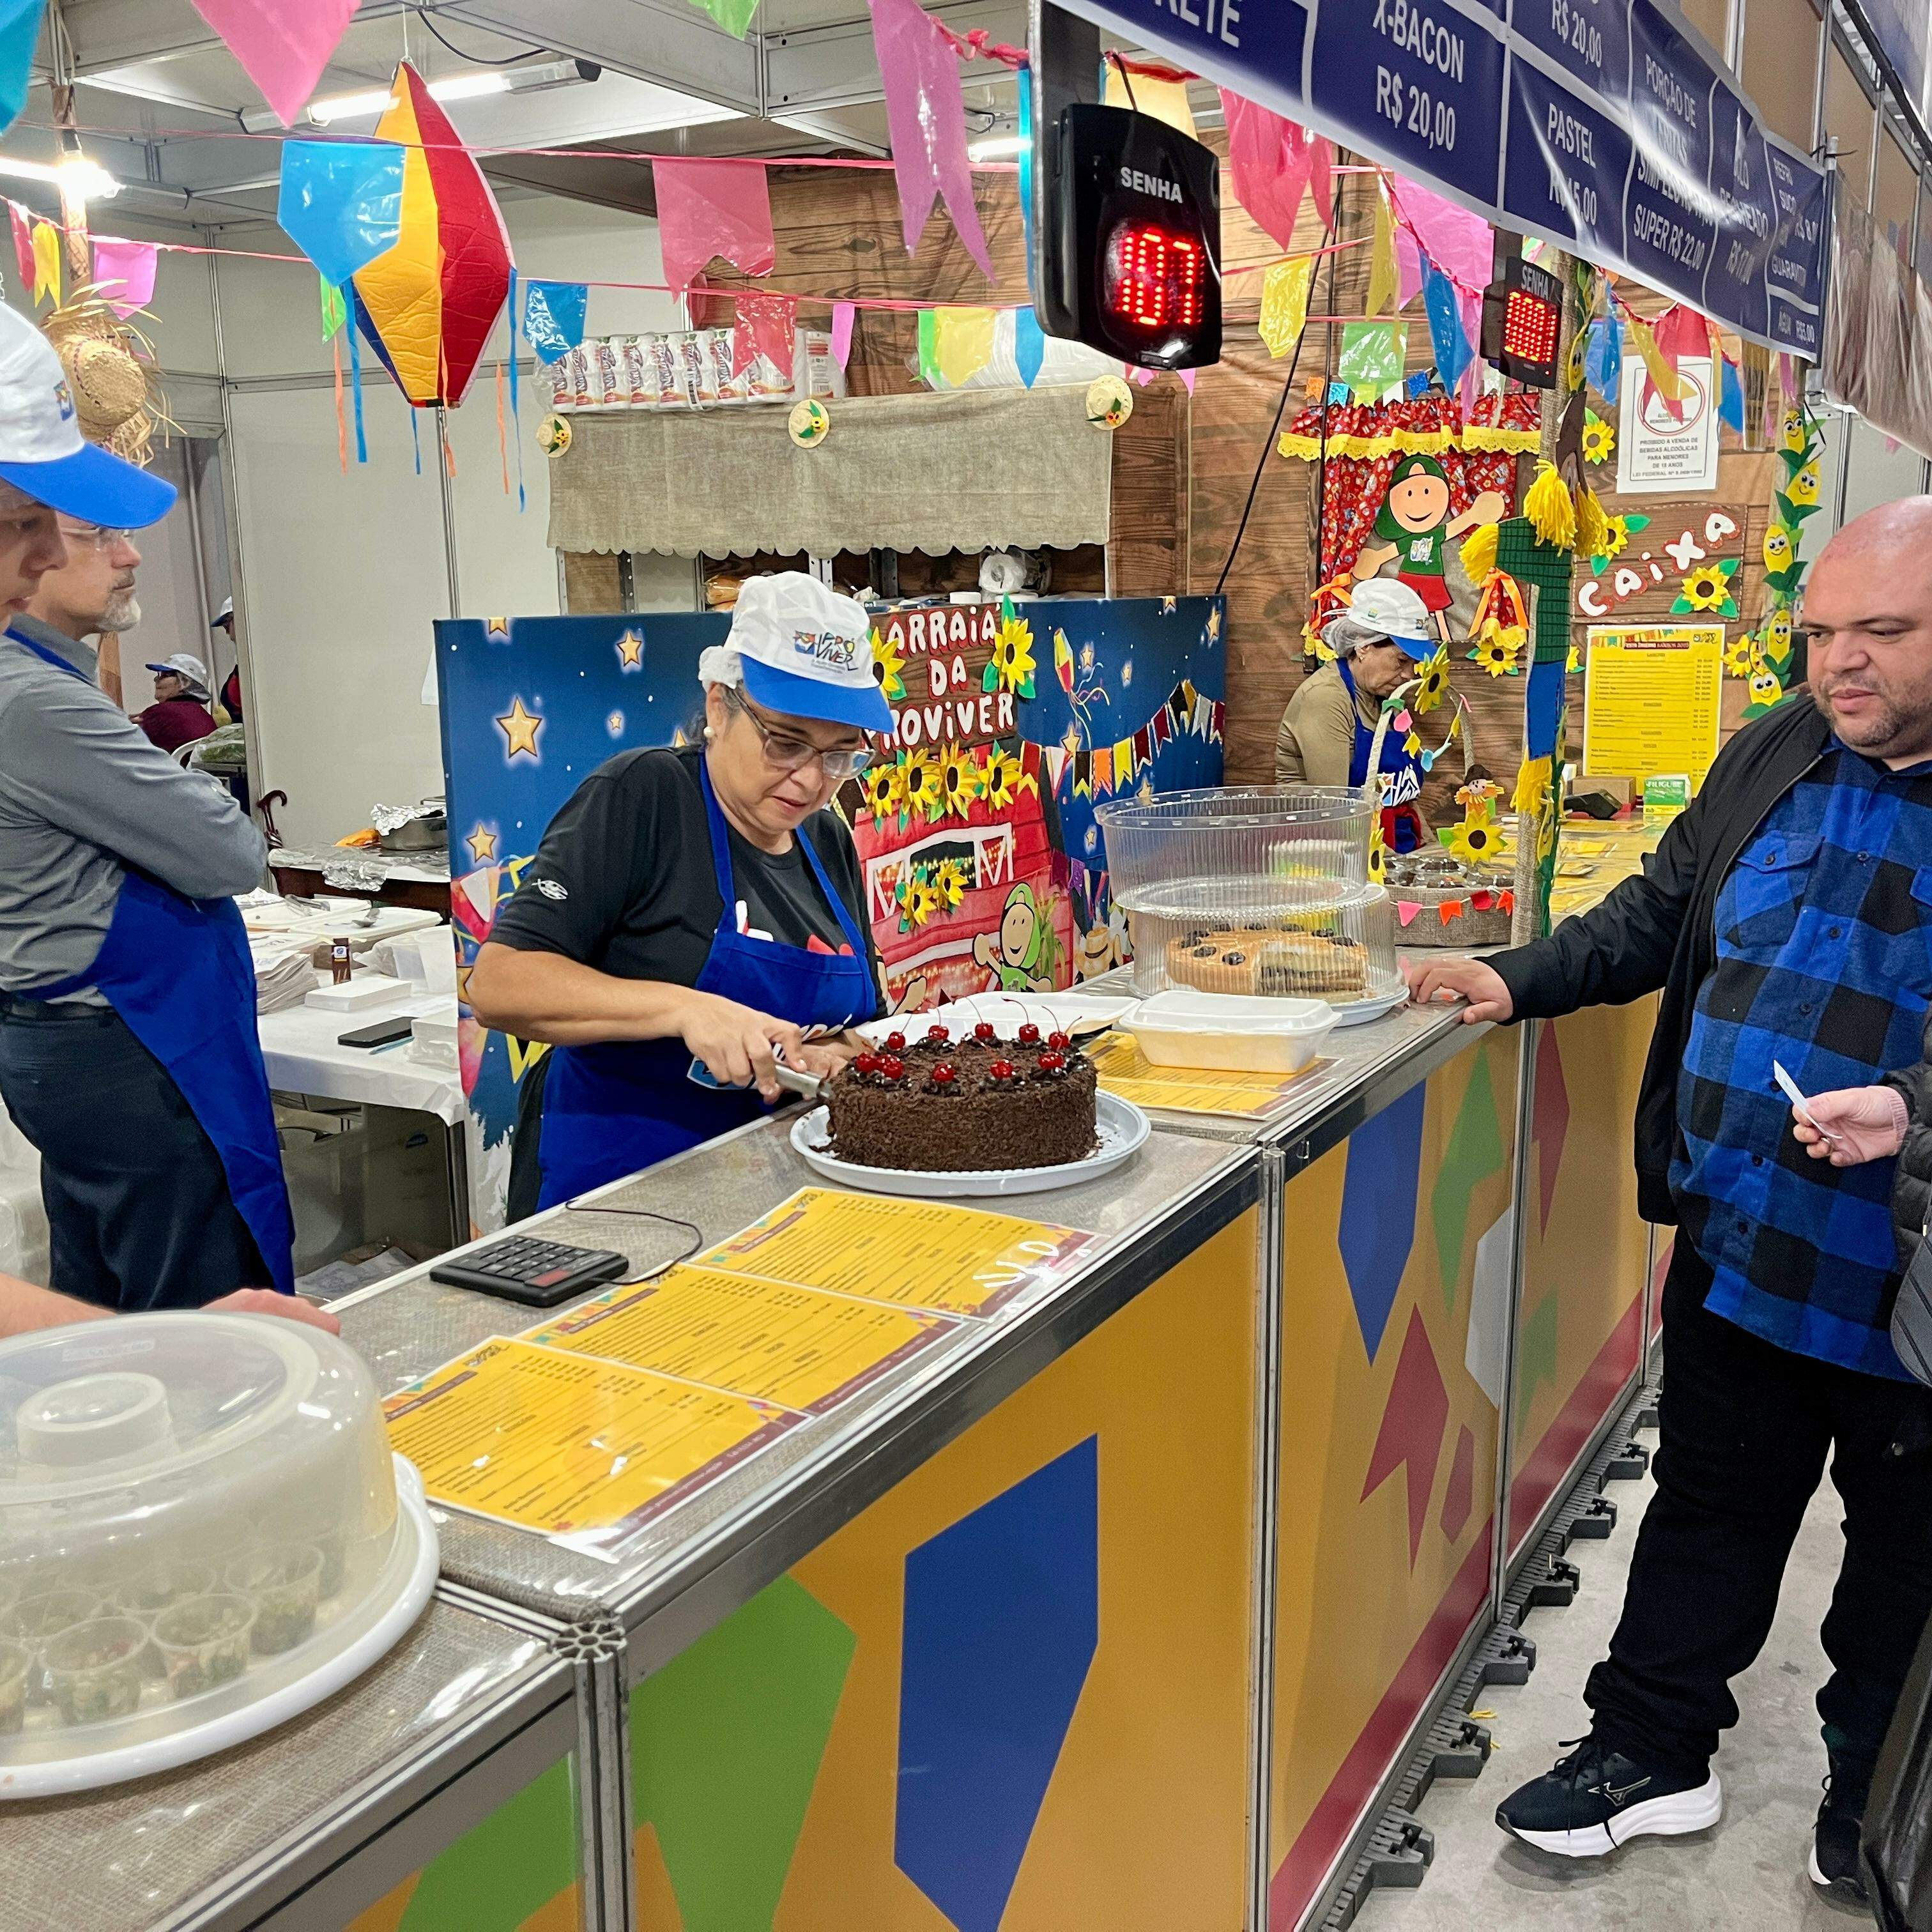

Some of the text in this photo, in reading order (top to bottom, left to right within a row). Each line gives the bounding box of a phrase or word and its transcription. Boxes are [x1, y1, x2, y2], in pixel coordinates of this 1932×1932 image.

[1373, 0, 1464, 83] X-BACON
[1552, 0, 1602, 68] R$ 20,00
[1377, 65, 1455, 151] R$ 20,00
[1548, 102, 1596, 169] PASTEL
[1683, 92, 1696, 128] DE
[1121, 167, 1183, 203] SENHA
[1634, 203, 1669, 252] SUPER
[1667, 224, 1683, 261] R$
[1521, 265, 1549, 300] SENHA
[930, 655, 967, 696] DA
